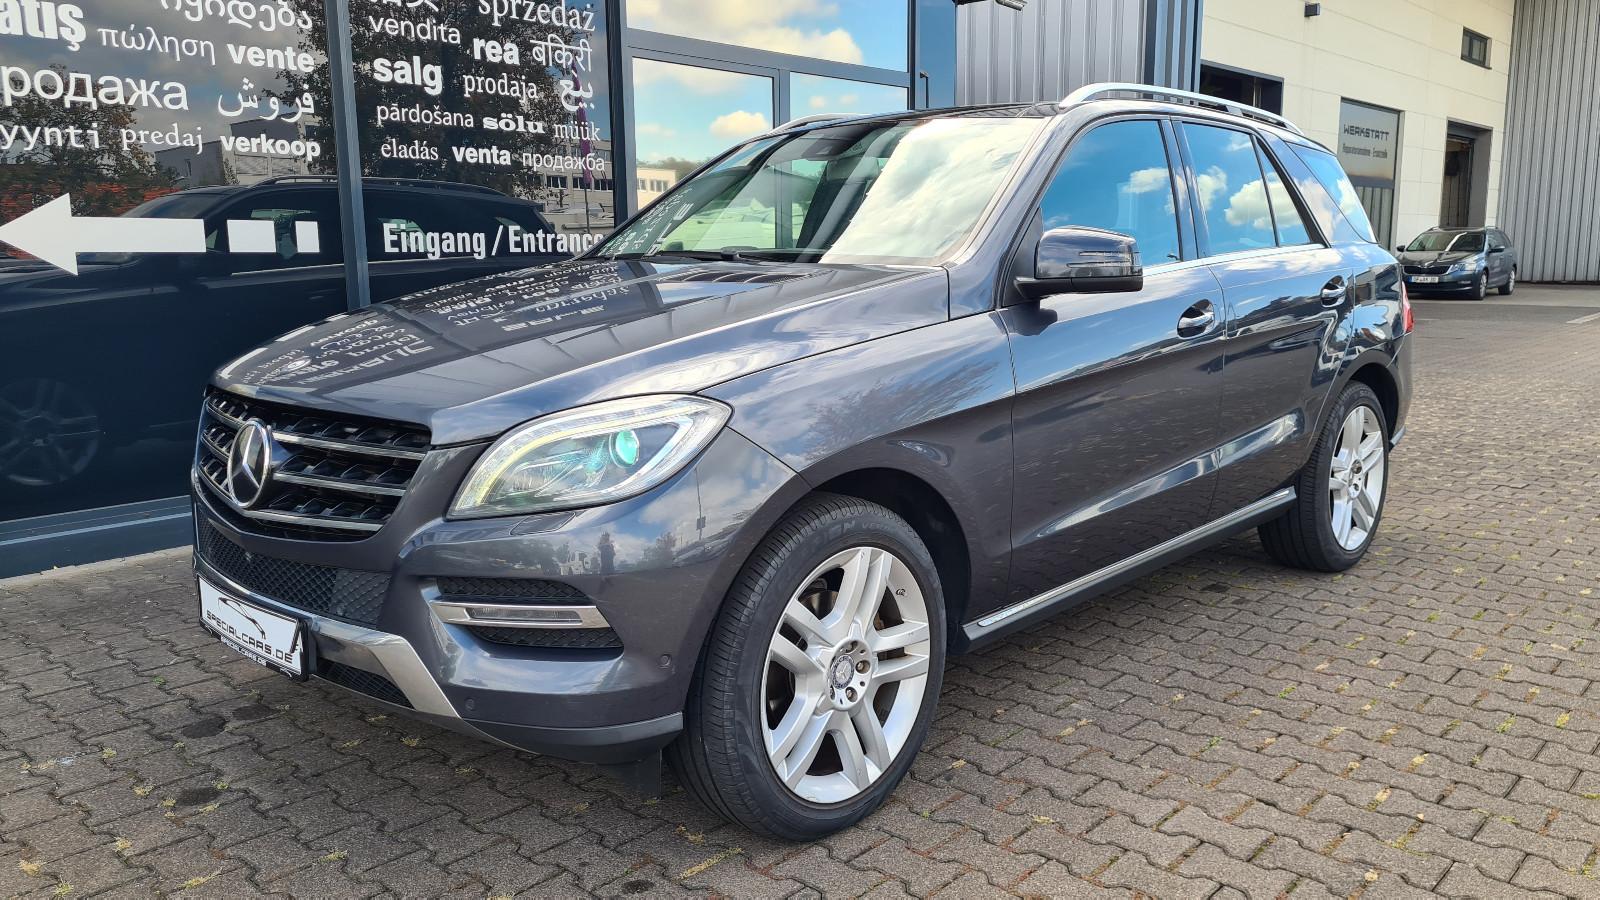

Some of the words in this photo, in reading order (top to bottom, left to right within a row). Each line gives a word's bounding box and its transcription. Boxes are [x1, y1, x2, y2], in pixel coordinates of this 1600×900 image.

[368, 15, 461, 45] vendita
[478, 0, 596, 32] sprzedaż
[96, 24, 216, 66] πώληση
[226, 43, 315, 73] vente
[473, 37, 520, 66] rea
[373, 55, 443, 96] salg
[463, 72, 538, 103] prodaja
[217, 77, 316, 123] فروش
[376, 102, 475, 128] pārdošana
[482, 112, 545, 134] sölu
[553, 121, 601, 141] müük
[1343, 124, 1389, 141] WERKSTATT
[120, 123, 203, 155] predaj
[220, 133, 321, 162] verkoop
[381, 138, 439, 161] eladás
[451, 145, 512, 166] venta
[522, 152, 605, 171] продажба
[382, 222, 486, 260] Eingang
[206, 609, 293, 664] SPECIALCARS.DE
